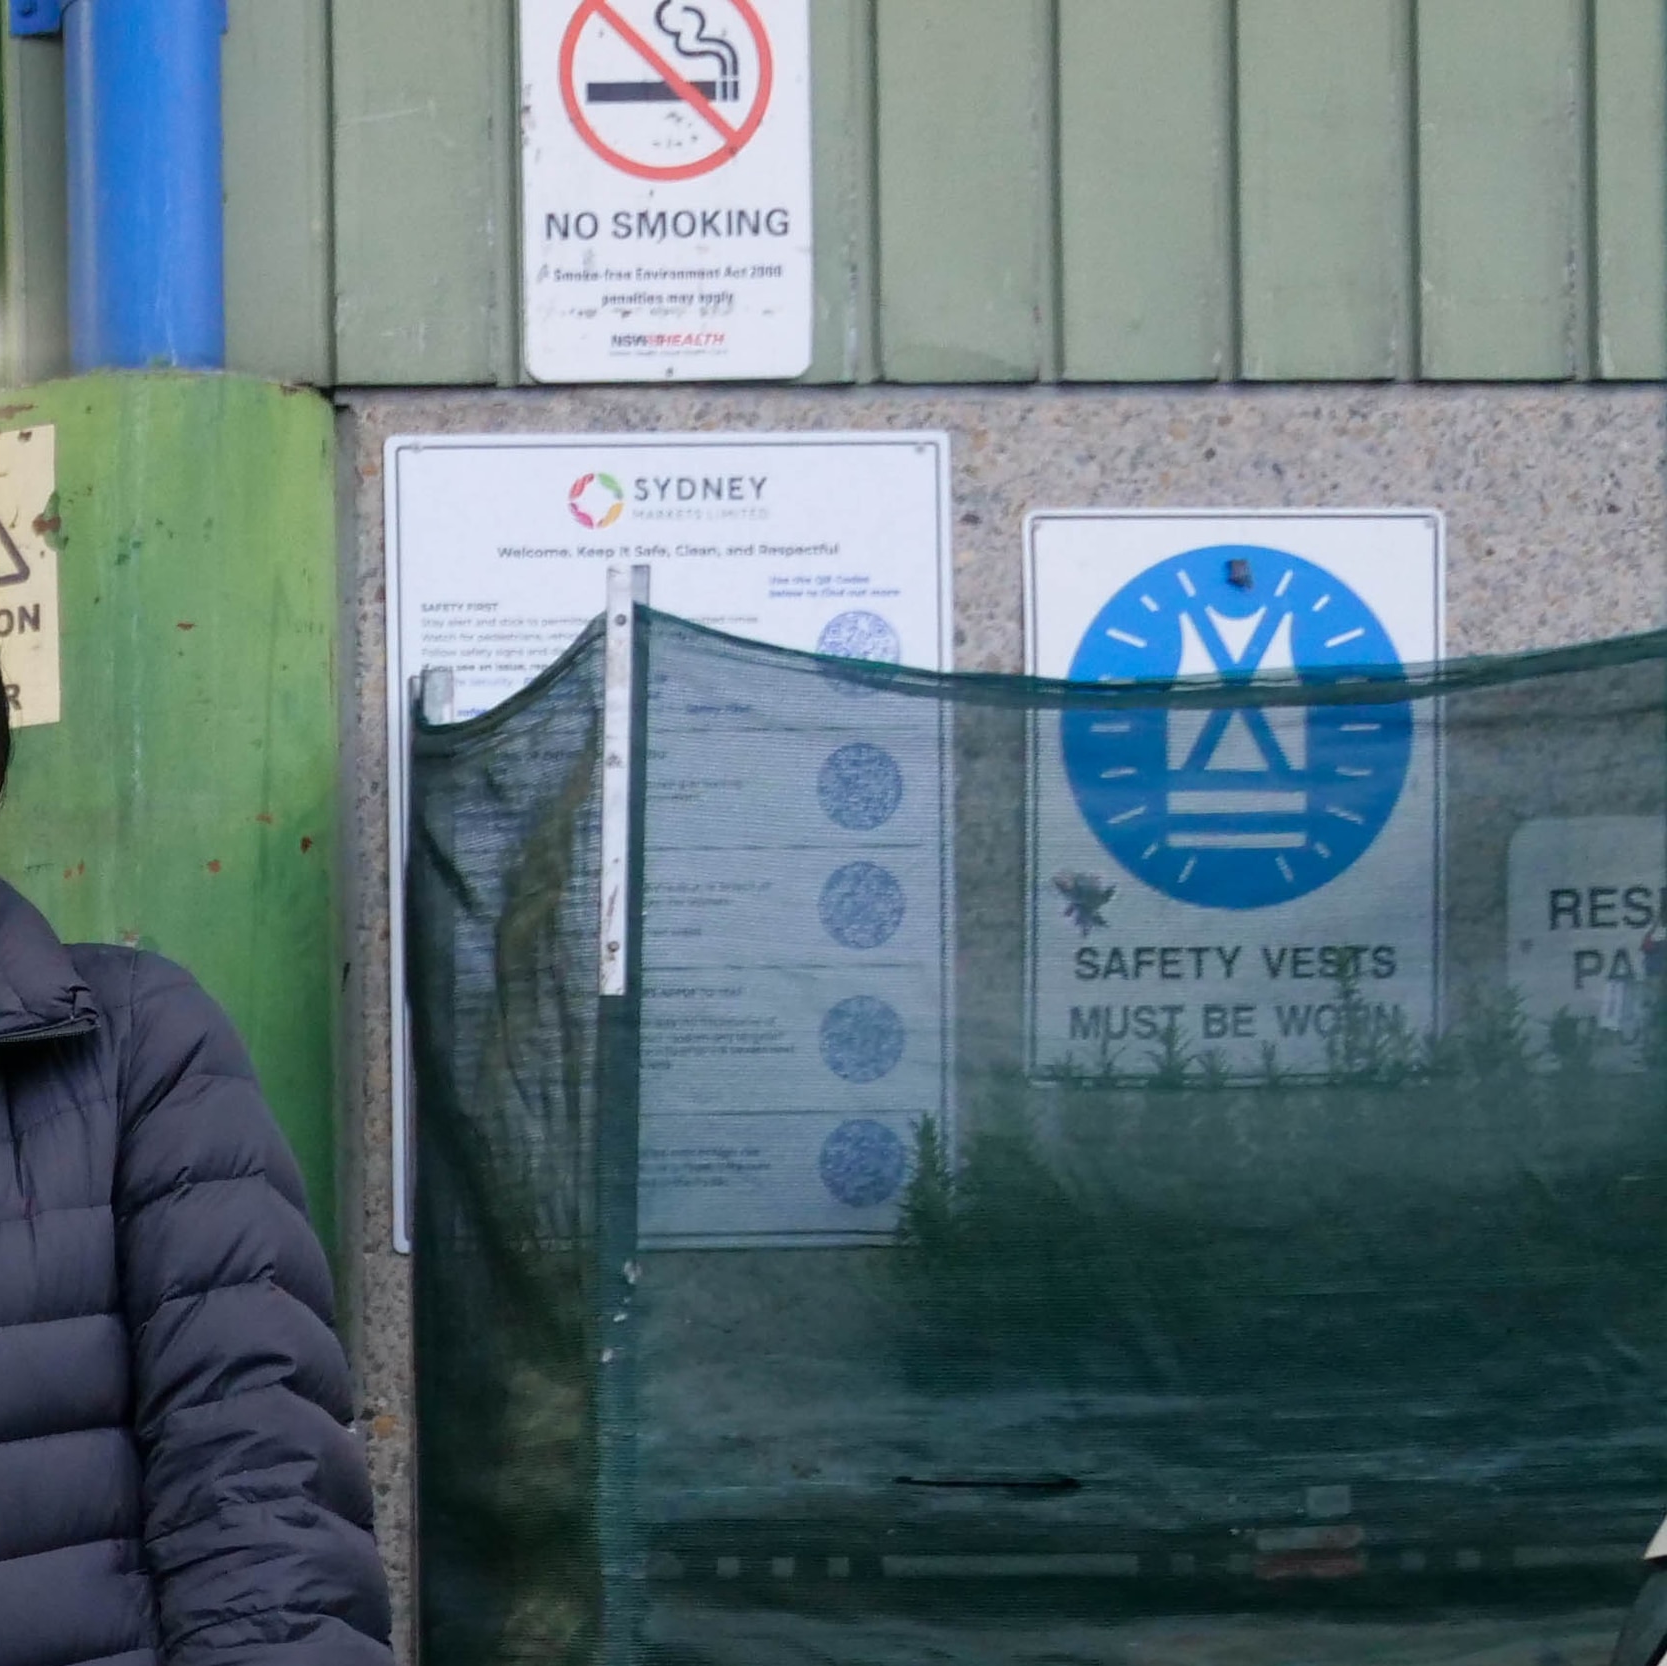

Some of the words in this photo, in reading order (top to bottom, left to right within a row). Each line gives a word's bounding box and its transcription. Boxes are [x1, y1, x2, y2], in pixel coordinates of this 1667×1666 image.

[545, 211, 599, 241] NO
[612, 207, 790, 240] SMOKING
[633, 475, 768, 501] SYDNEY
[632, 507, 702, 520] MARKETS
[707, 507, 769, 520] LIMITED
[577, 546, 615, 562] Keep
[726, 544, 754, 557] and
[759, 542, 839, 560] Respectful
[420, 602, 465, 612] SAFETY
[468, 602, 498, 612] FIRST
[1549, 886, 1667, 930] RES
[1074, 945, 1242, 980] SAFETY
[1263, 944, 1398, 980] VESTS
[1069, 1004, 1185, 1041] MUST
[1202, 1004, 1258, 1039] BE
